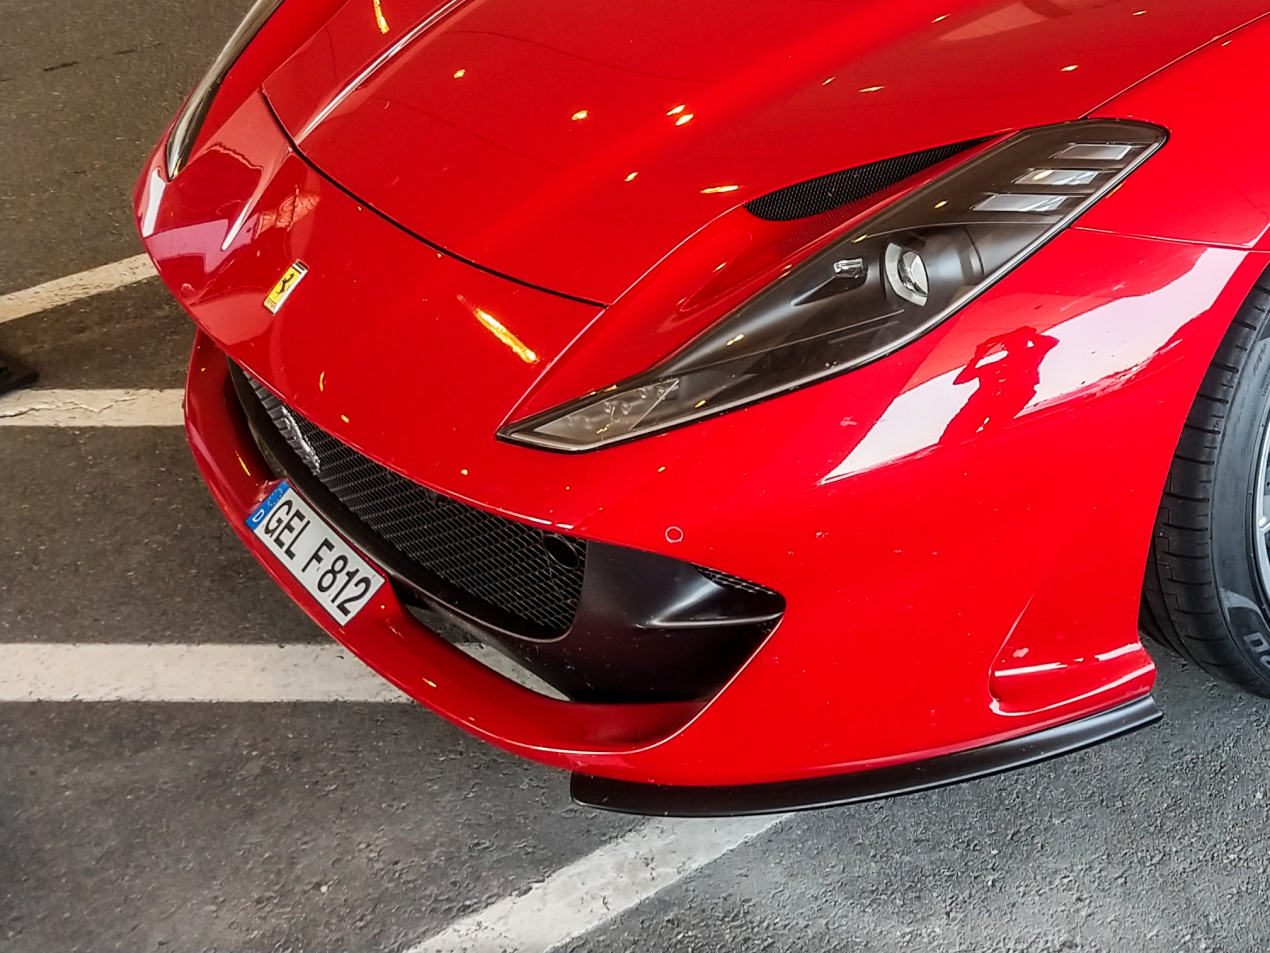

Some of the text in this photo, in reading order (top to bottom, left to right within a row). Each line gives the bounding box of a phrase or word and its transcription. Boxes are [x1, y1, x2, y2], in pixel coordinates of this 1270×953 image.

[252, 509, 265, 523] D
[264, 499, 372, 617] GEL F 812
